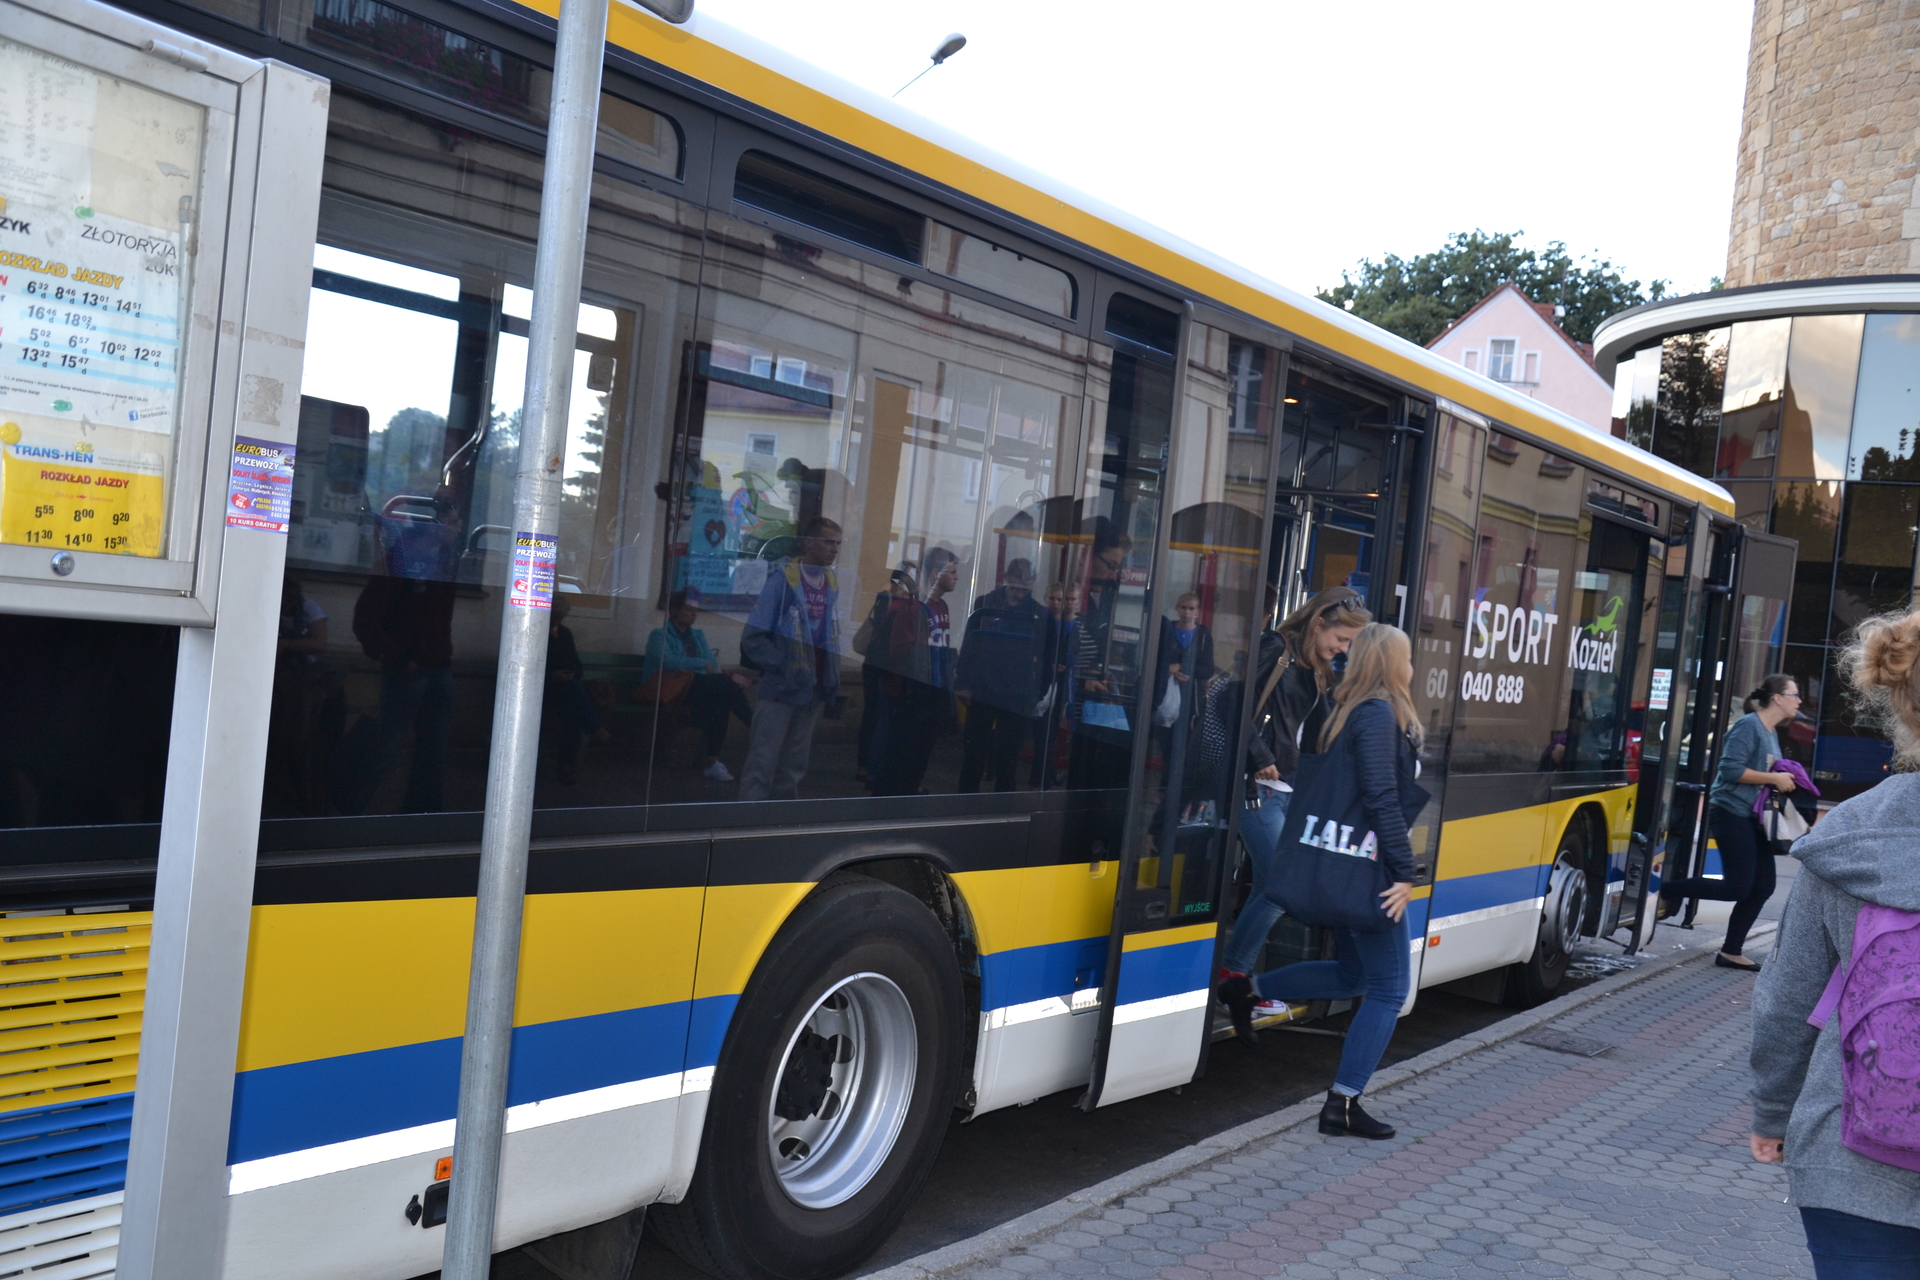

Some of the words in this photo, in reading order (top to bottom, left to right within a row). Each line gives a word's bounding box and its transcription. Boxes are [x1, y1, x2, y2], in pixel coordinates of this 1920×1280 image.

[81, 224, 177, 259] ZŁOTORYJA
[71, 267, 124, 290] JAZDY
[13, 444, 93, 463] TRANS-HEN
[235, 443, 279, 458] EUROBUS
[234, 456, 280, 470] PRZEWOZY
[41, 470, 91, 484] ROZKŁAD
[95, 477, 130, 488] JAZDY
[255, 521, 278, 529] GRATIS!
[1462, 671, 1493, 703] 040
[1496, 674, 1524, 704] 888
[1299, 814, 1378, 862] LALA
[1184, 902, 1211, 914] WYJŚCIE
